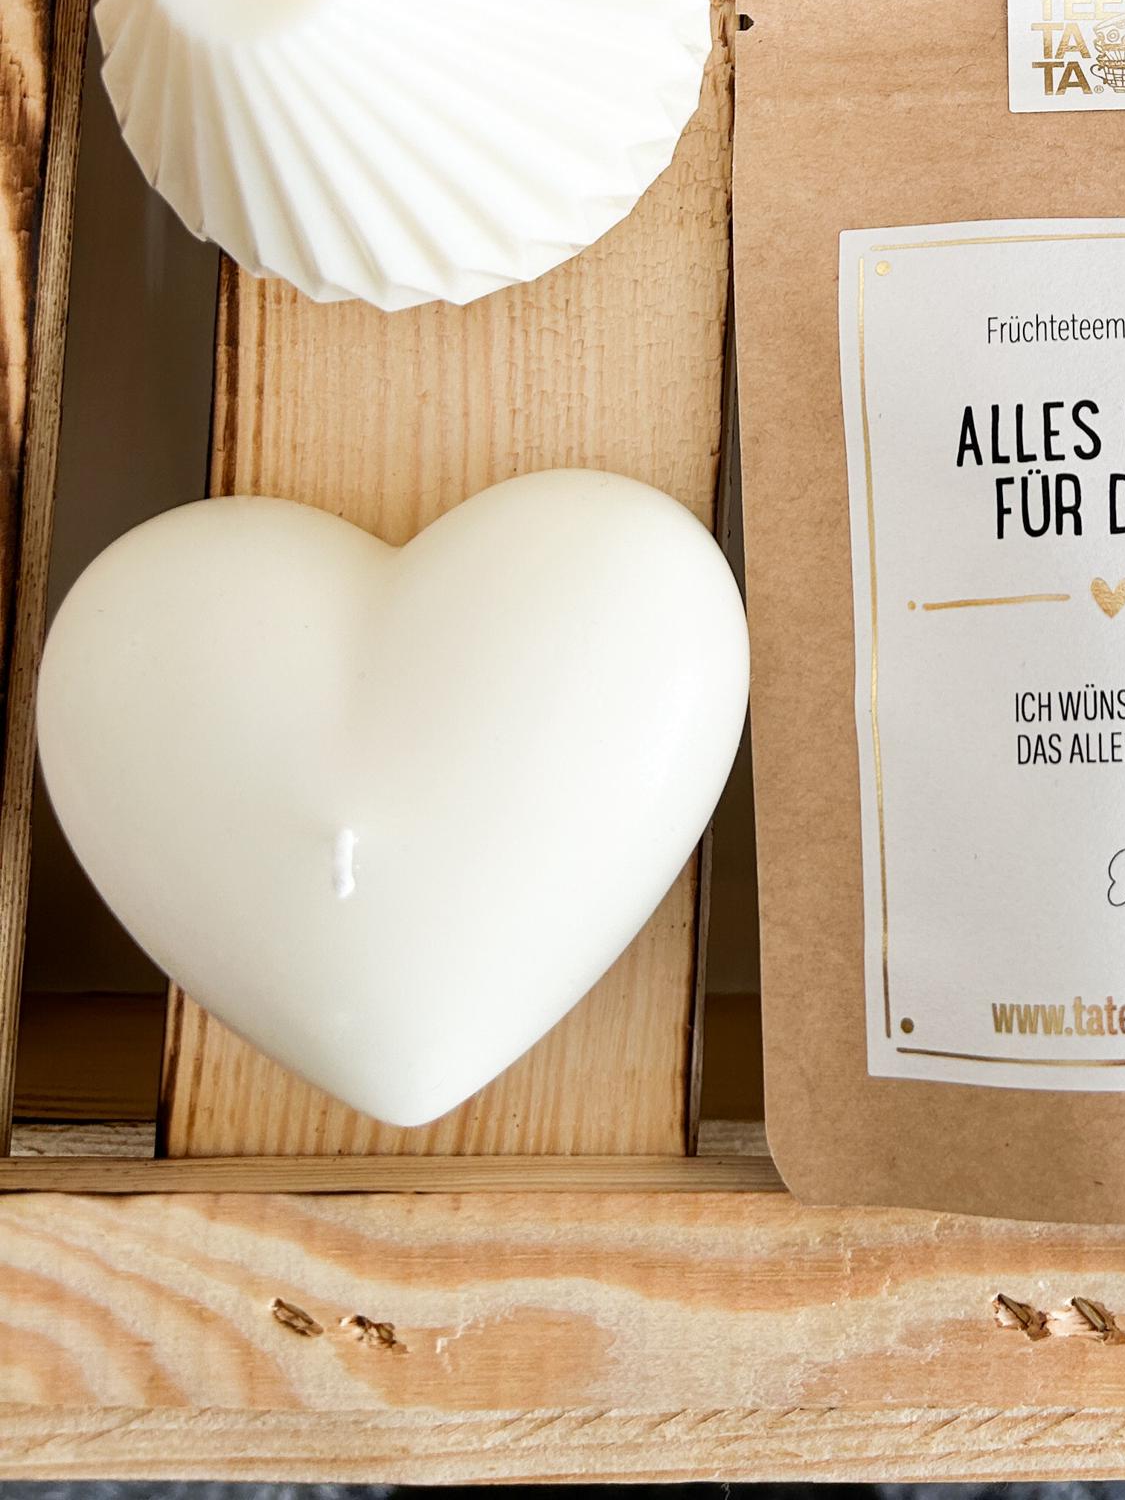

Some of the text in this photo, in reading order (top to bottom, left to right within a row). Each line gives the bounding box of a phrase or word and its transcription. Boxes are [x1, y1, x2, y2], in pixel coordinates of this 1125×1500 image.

[1031, 22, 1092, 59] TA
[956, 399, 1102, 467] ALLES
[995, 469, 1083, 539] FÜR
[1015, 691, 1052, 722] ICH
[1017, 733, 1062, 765] DAS
